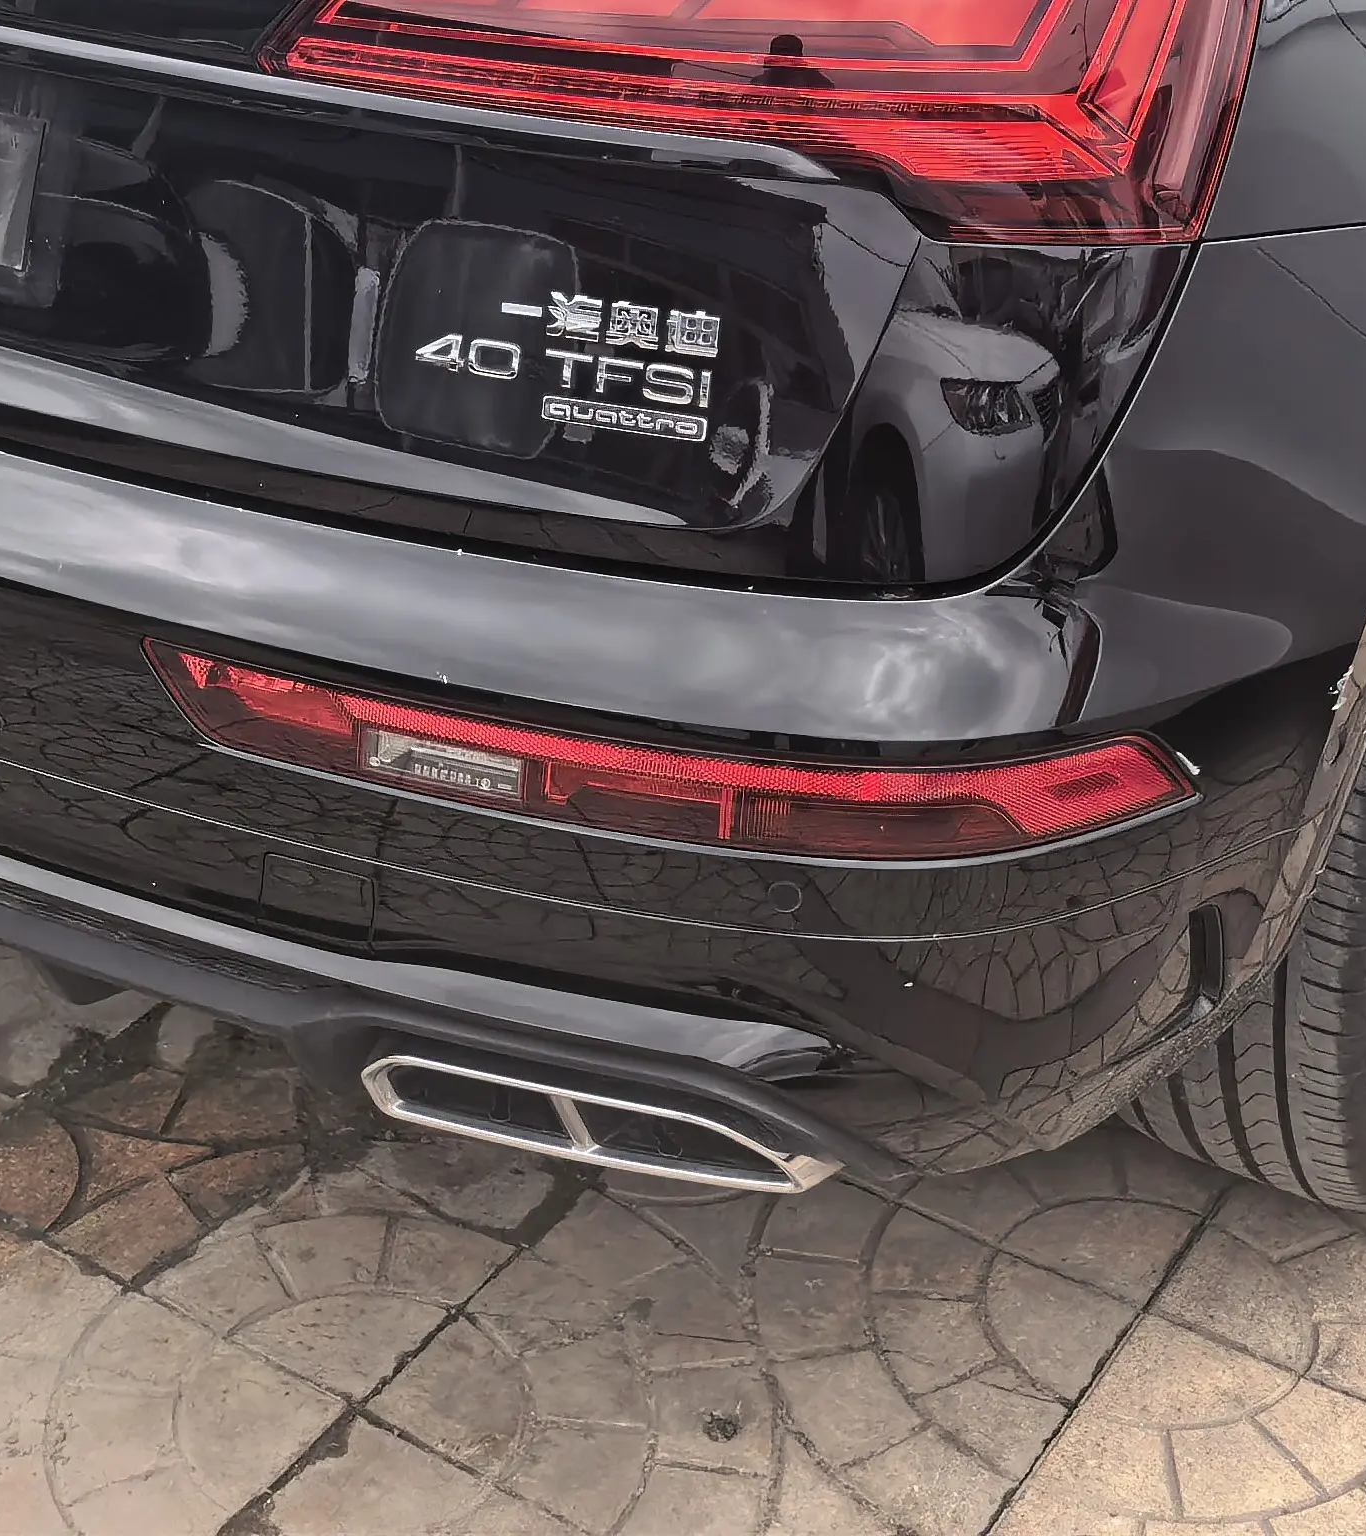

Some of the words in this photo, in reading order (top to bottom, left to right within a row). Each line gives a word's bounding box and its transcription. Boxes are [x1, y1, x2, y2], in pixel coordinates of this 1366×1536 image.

[501, 290, 720, 358] 一汽奥迪
[415, 334, 521, 380] 40
[545, 348, 712, 408] TFSI
[547, 400, 700, 437] quattro
